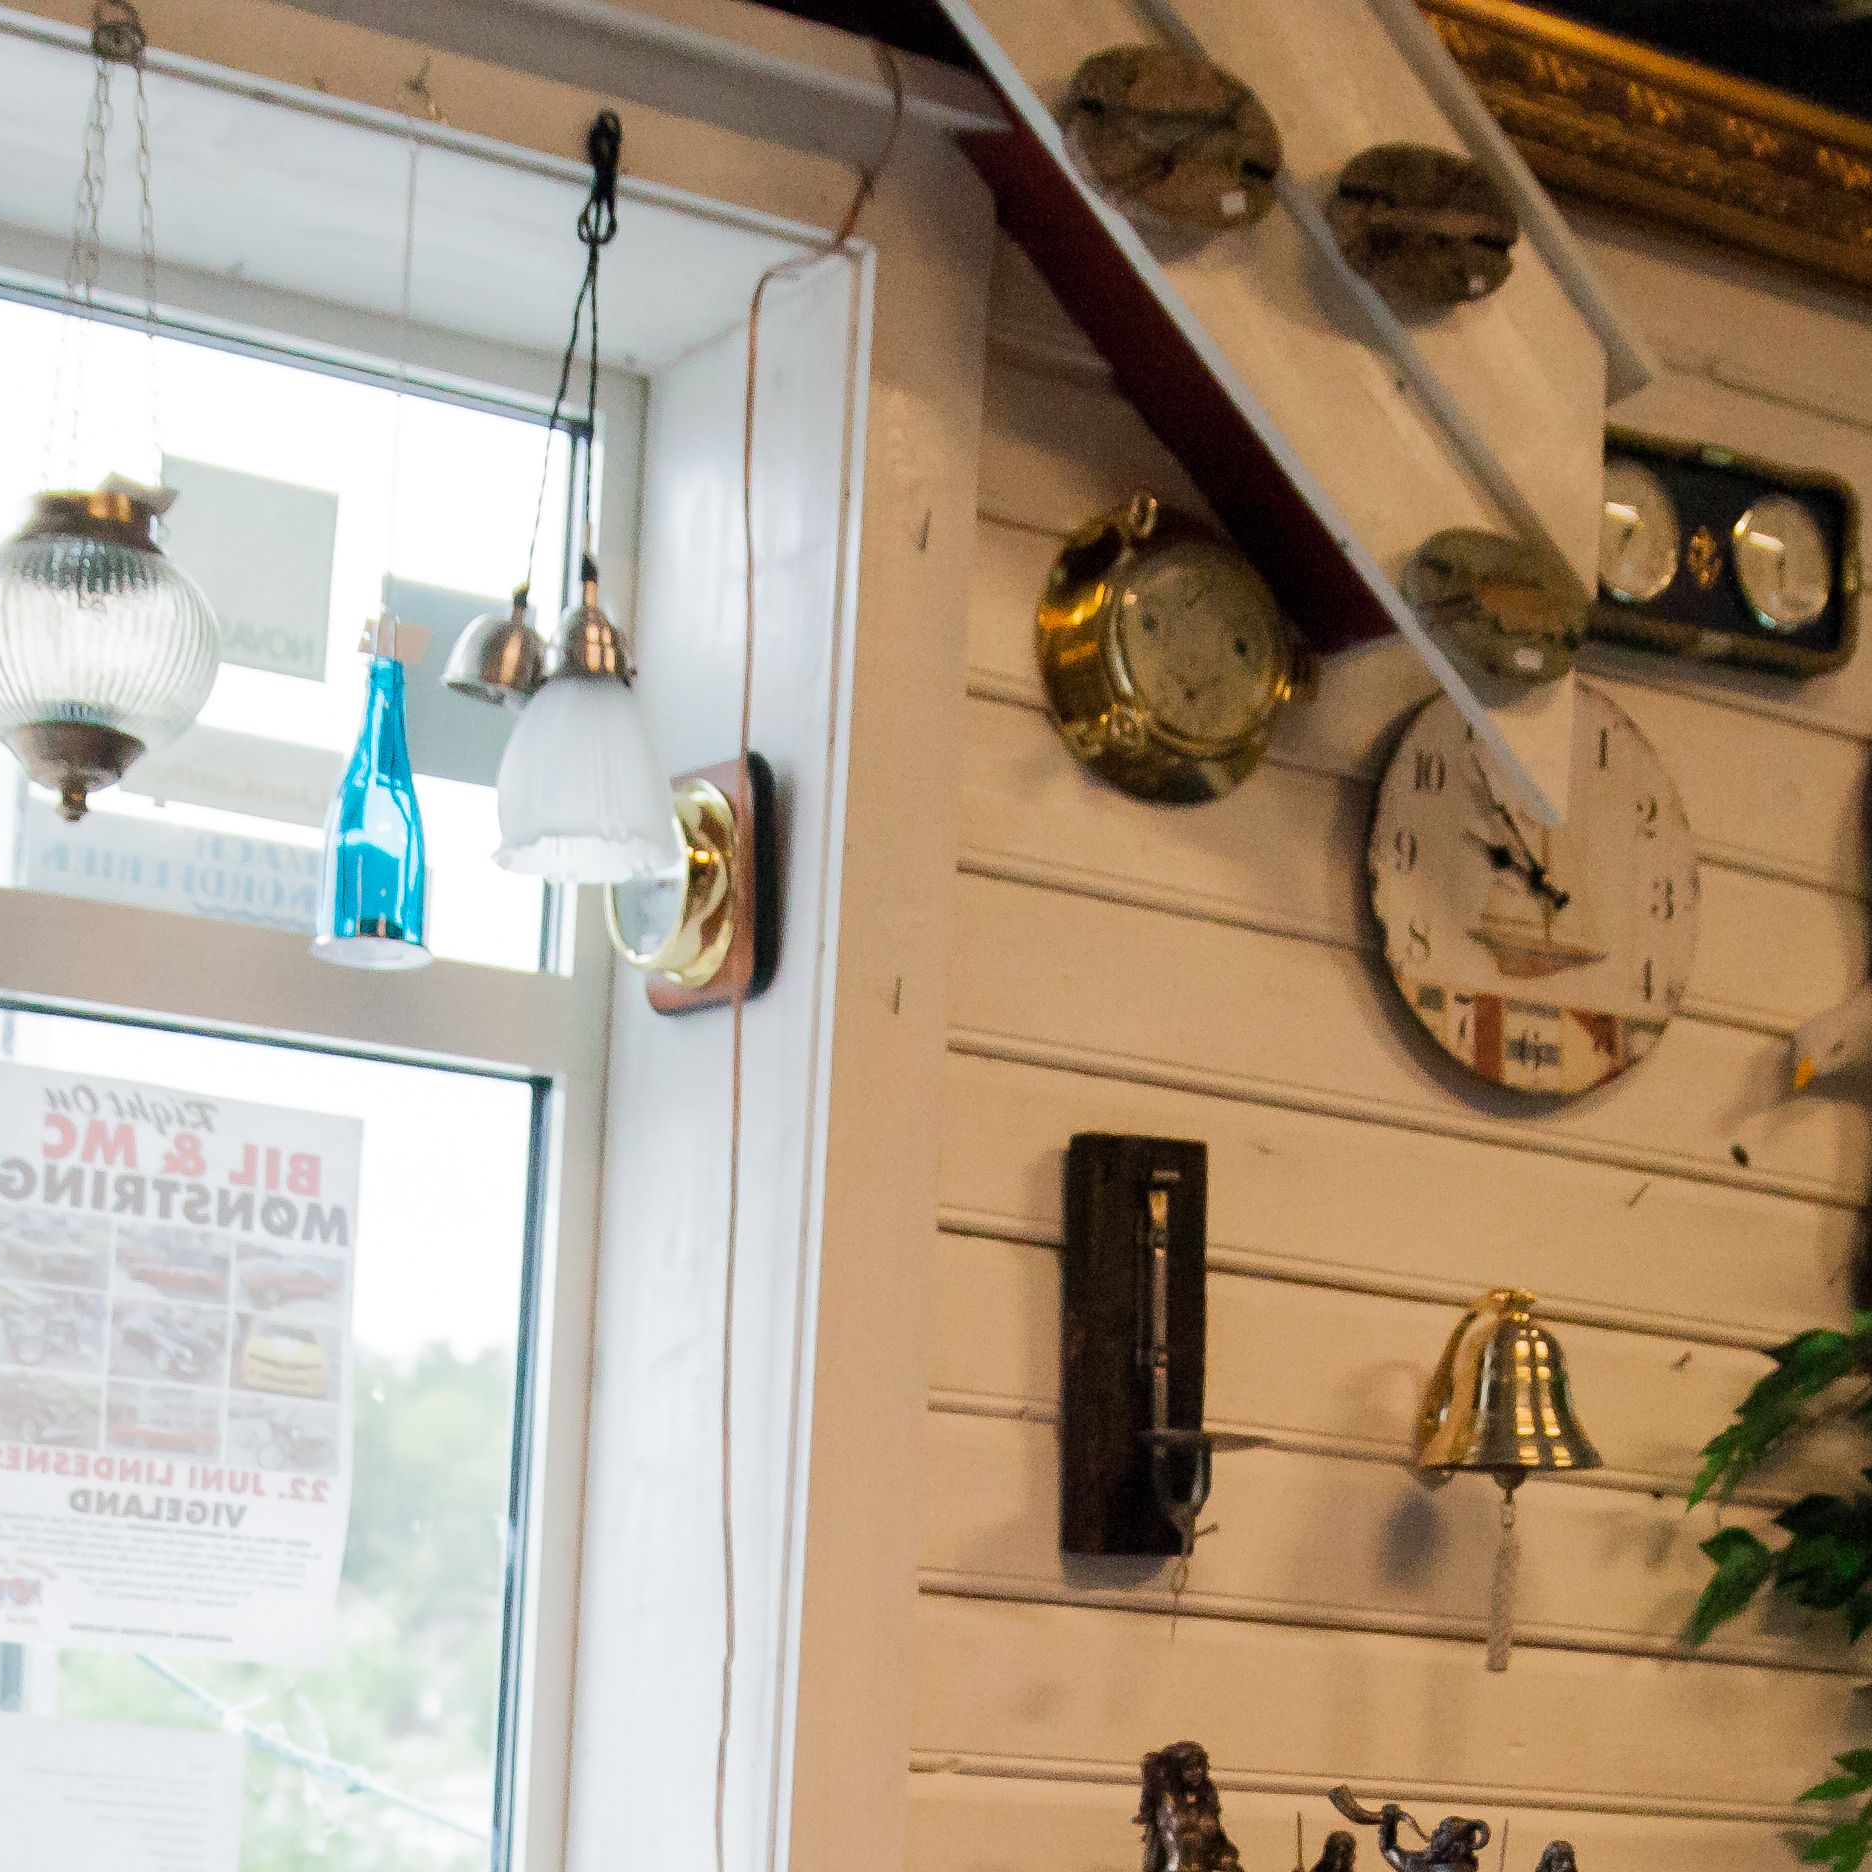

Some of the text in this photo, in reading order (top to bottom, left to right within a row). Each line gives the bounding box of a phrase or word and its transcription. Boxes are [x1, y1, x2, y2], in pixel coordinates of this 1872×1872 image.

[1414, 749, 1448, 793] 10
[1635, 794, 1659, 840] 2
[1650, 876, 1676, 921] 3
